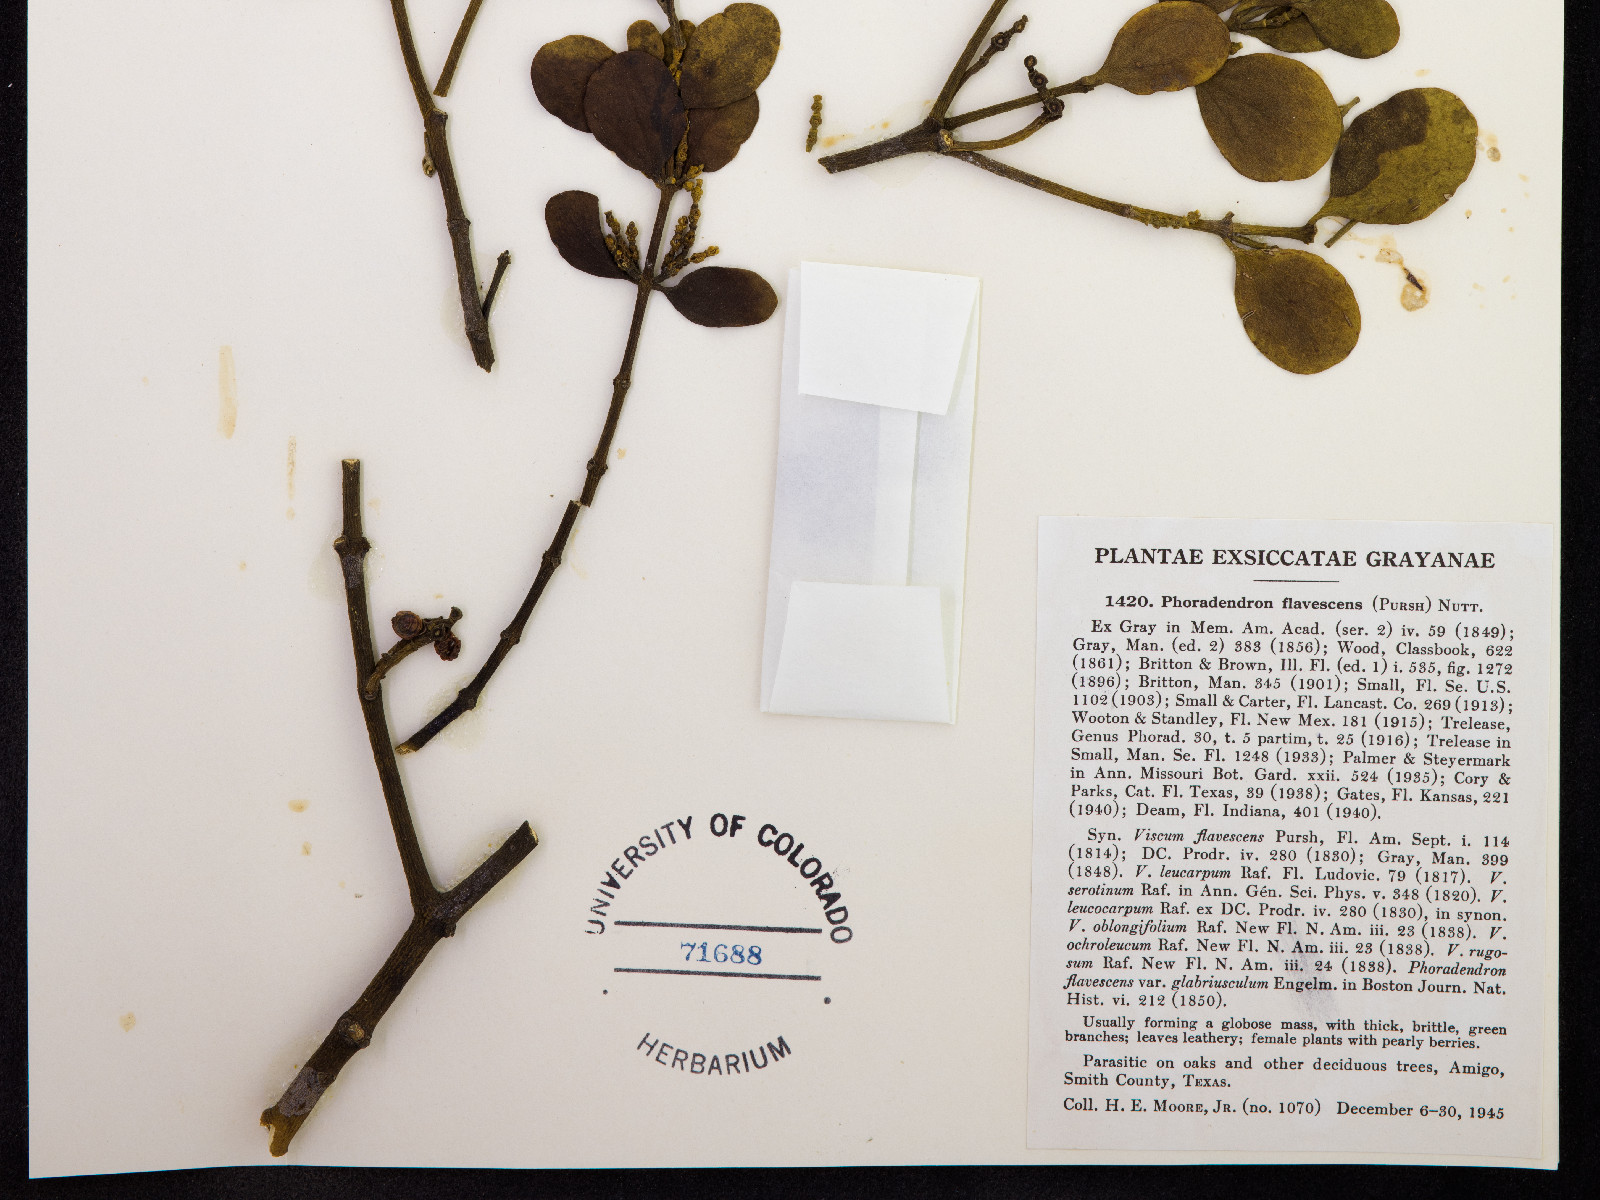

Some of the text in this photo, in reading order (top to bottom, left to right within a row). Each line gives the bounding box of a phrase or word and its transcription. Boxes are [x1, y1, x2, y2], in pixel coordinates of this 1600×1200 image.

[1094, 547, 1496, 569] PLANTAE EXSICCATAE GRAYANAE
[1105, 595, 1154, 608] 1420.
[1161, 595, 1274, 609] Phoradendron
[1282, 596, 1363, 610] flavescens
[1090, 619, 1514, 642] Ex Gray in Mem. Am. Acad. (ser. 2) iv. 59 (1849);
[1072, 636, 1513, 659] Gray, Man. (ed. 2) 383 (1856); Wood, Classbook, 622
[1071, 710, 1510, 733] Wooton & Standley, Fl. New Mex. 181 (1915); Trelease,
[1071, 747, 1511, 769] Small, Man. Se. Fl. 1248 (1933); Palmer & Steyermark
[1069, 799, 1381, 822] (1940); Deam, Fl. Indiana, 401 (1940).
[584, 812, 853, 944] UNIVERSITY OF COLORADO
[680, 941, 763, 966] 71688
[1062, 973, 1506, 995] flavescens var. glabriusculum Engelm. in Boston Journ. Nat.
[1066, 990, 1227, 1010] Hist. vi. 212 (1850).
[1082, 1015, 1507, 1037] Usually forming a globose mass, with thick, brittle, green
[1064, 1029, 1480, 1050] branches; leaves leathery; female plants with pearly berries.
[636, 1032, 792, 1076] HERBARIUM
[1083, 1054, 1504, 1079] Parasitic on oaks and other deciduous trees, Amigo,
[1064, 1071, 1109, 1086] Smith
[1116, 1073, 1176, 1090] County,
[1063, 1097, 1098, 1112] Coll.
[1105, 1098, 1125, 1112] H.
[1130, 1098, 1147, 1112] E.
[1242, 1097, 1272, 1116] (no.
[1279, 1098, 1321, 1116] 1070)
[1336, 1101, 1414, 1116] December
[1470, 1106, 1504, 1120] 1945
